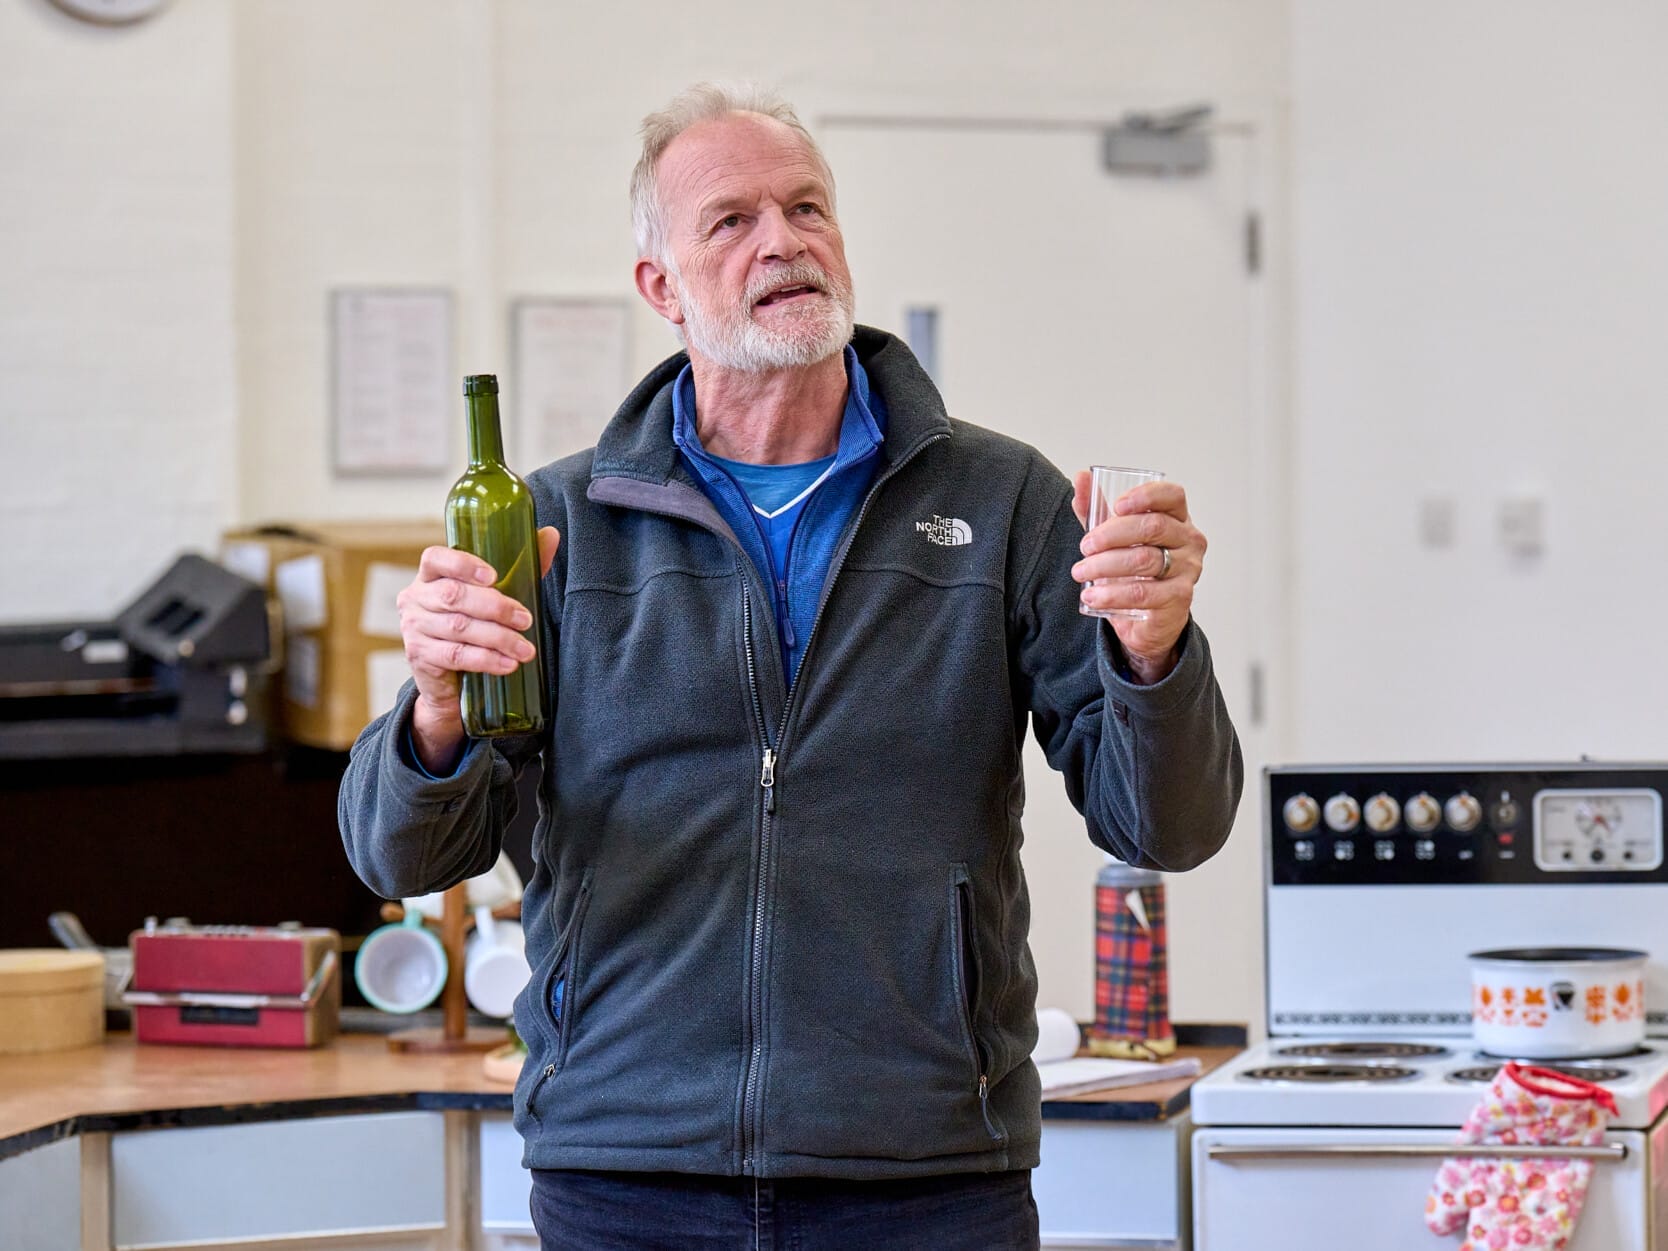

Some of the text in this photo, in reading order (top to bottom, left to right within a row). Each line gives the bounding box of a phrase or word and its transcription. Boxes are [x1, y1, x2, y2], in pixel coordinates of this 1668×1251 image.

[933, 514, 953, 528] THE
[915, 521, 952, 537] NORTH
[927, 532, 952, 546] FACE
